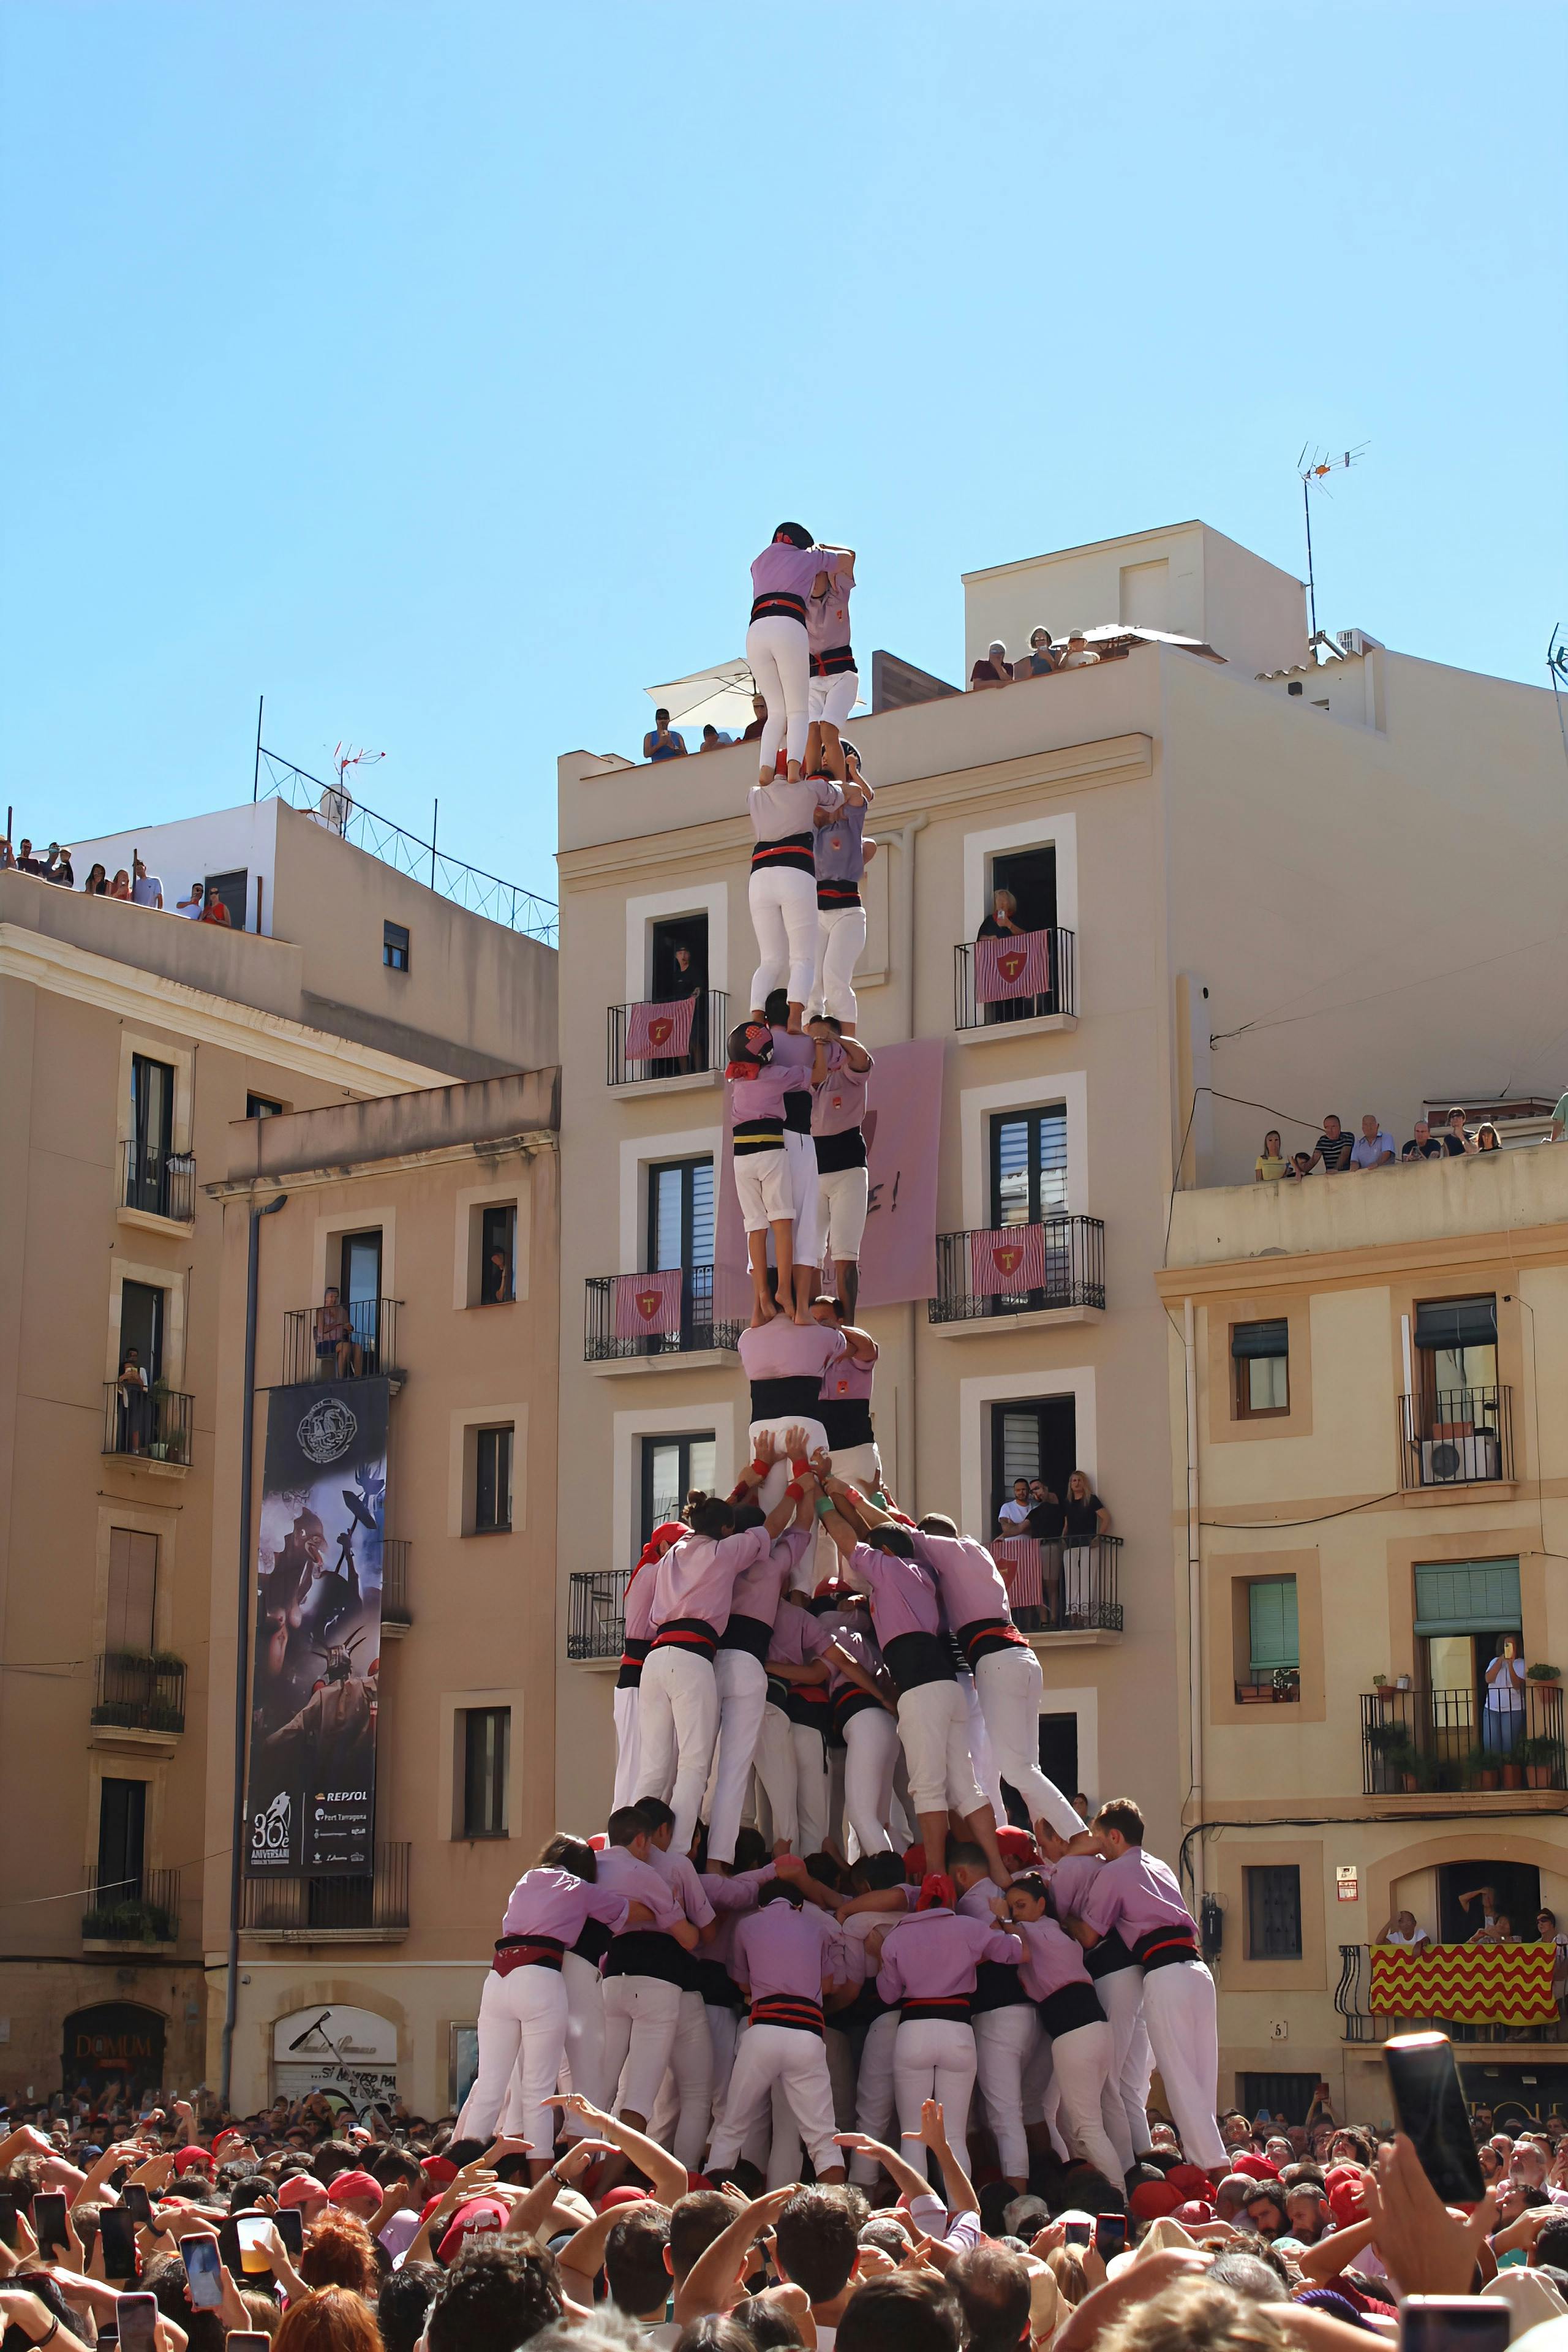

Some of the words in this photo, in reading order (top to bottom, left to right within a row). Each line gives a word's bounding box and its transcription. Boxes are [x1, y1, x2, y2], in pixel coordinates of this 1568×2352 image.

[1006, 960, 1019, 975] T
[1002, 1253, 1014, 1269] T
[643, 1298, 654, 1313] T
[326, 1791, 367, 1801] REPSOL
[1275, 2024, 1281, 2036] 5
[75, 2034, 153, 2059] DOMUM
